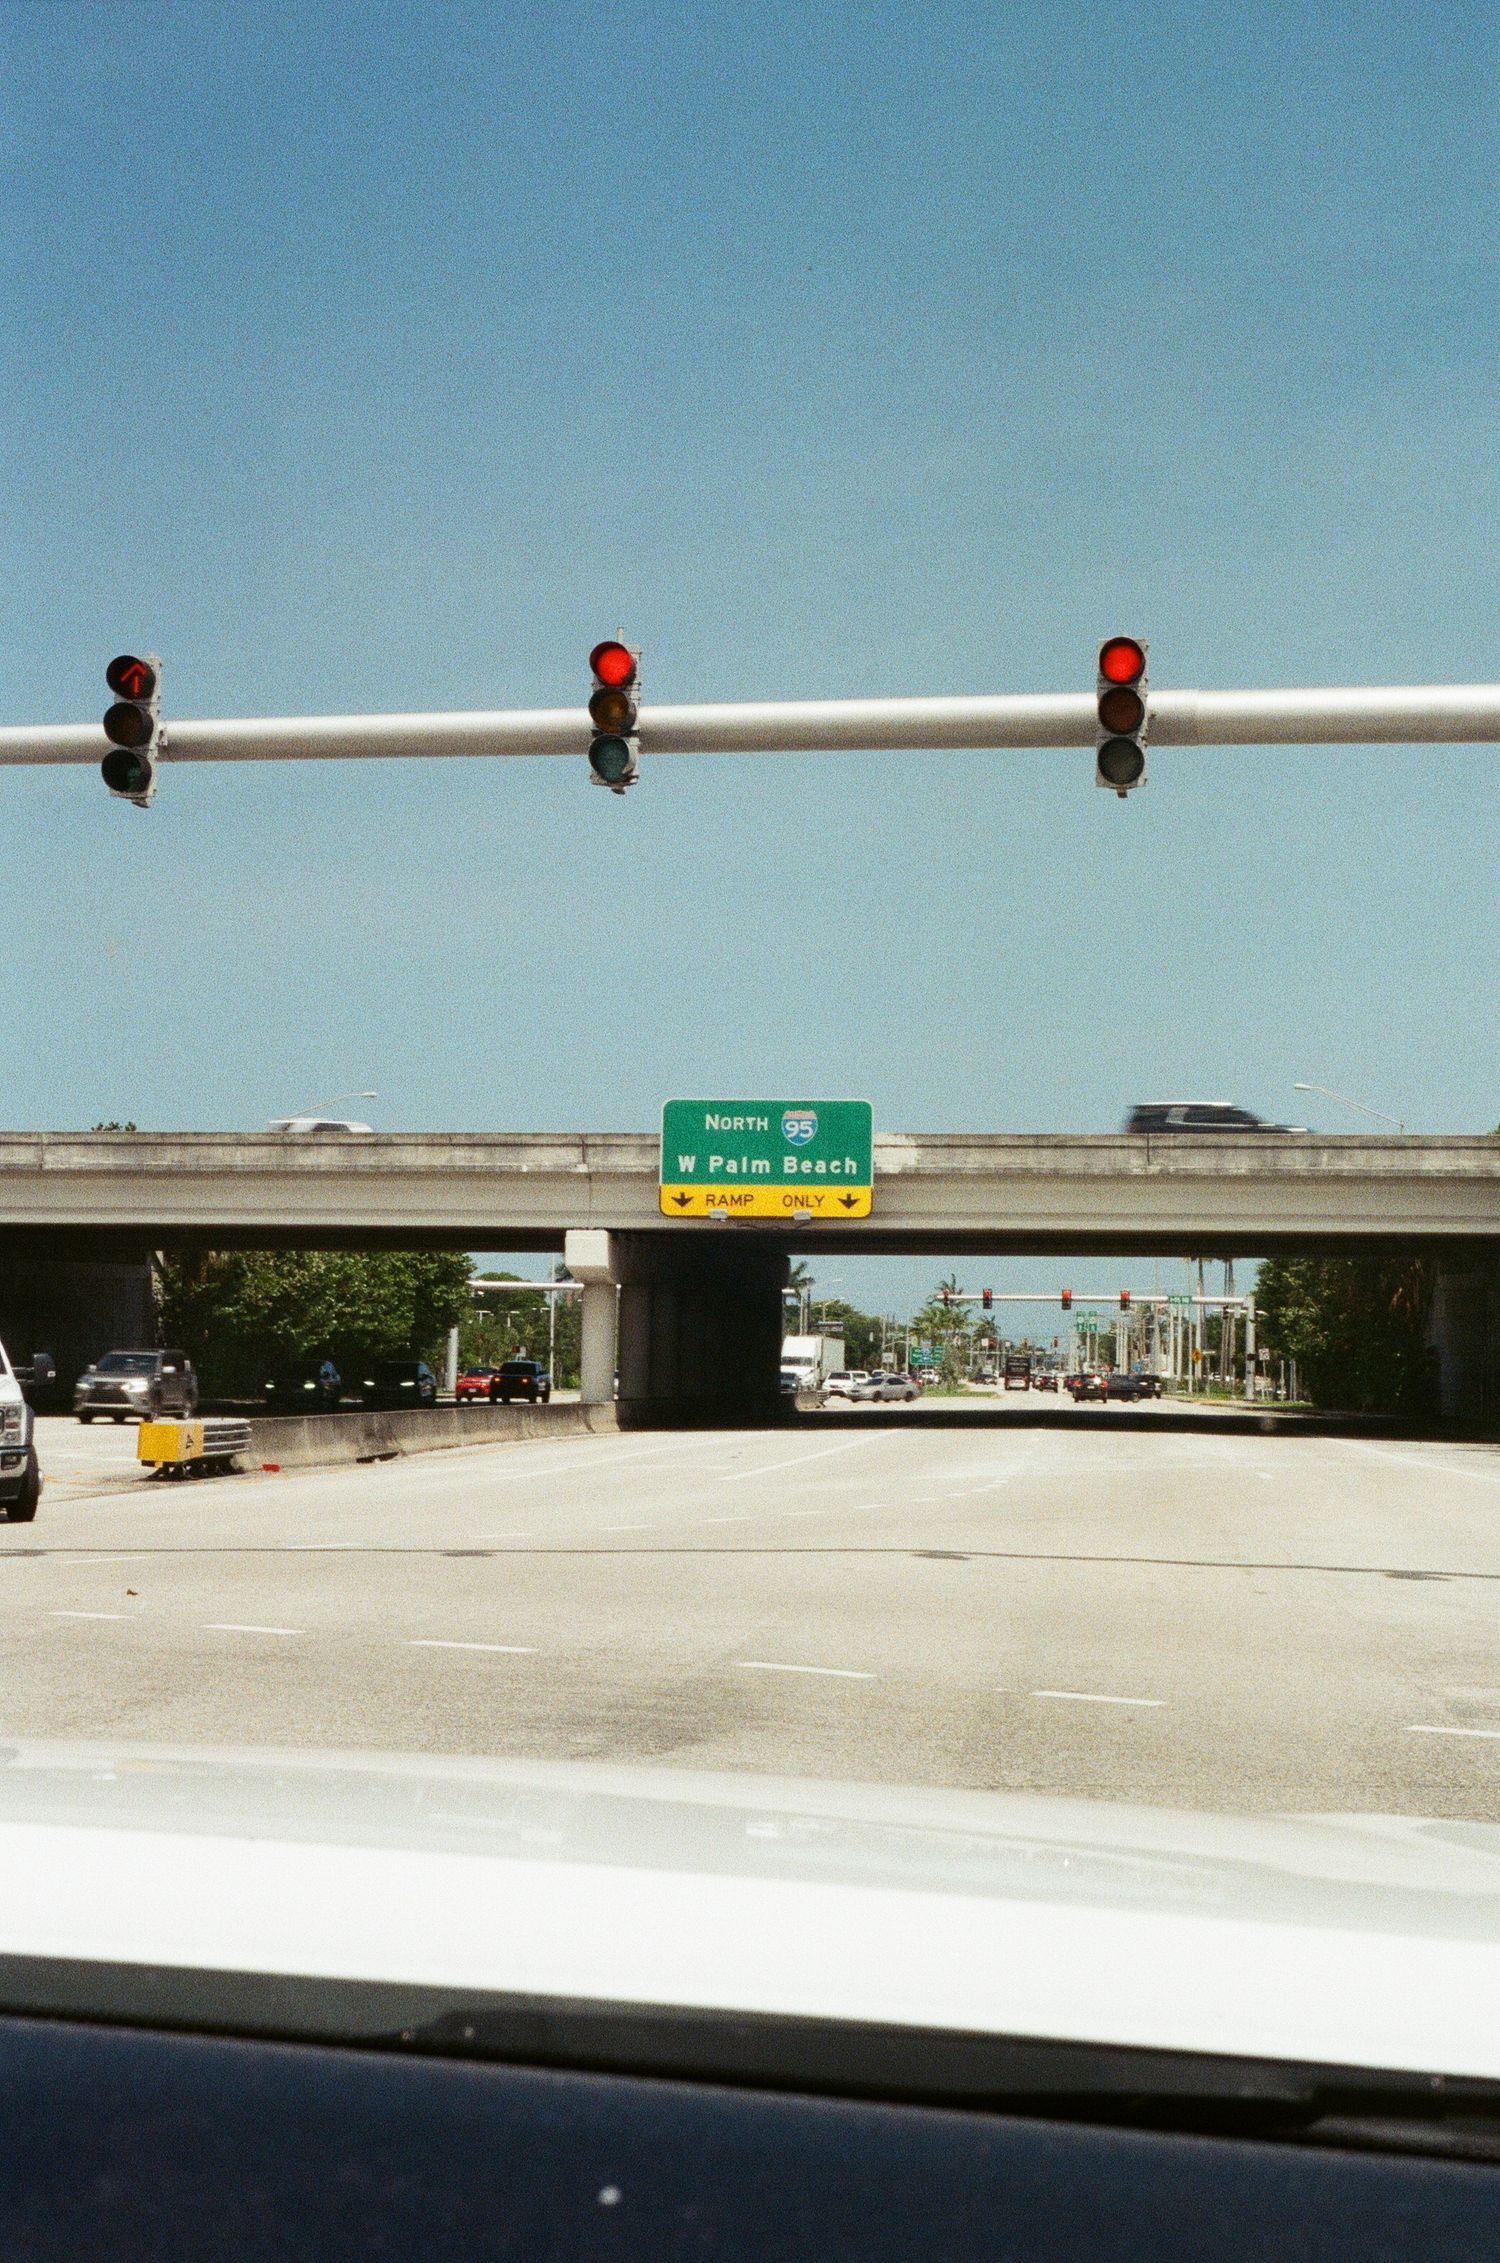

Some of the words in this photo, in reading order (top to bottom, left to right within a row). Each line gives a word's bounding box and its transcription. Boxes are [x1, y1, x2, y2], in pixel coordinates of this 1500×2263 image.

[704, 1113, 769, 1131] NORTH
[784, 1120, 814, 1138] 95
[677, 1155, 696, 1173] W
[708, 1155, 770, 1174] Palm
[783, 1156, 858, 1175] Beach
[705, 1194, 755, 1207] RAMP
[782, 1195, 826, 1208] ONLY
